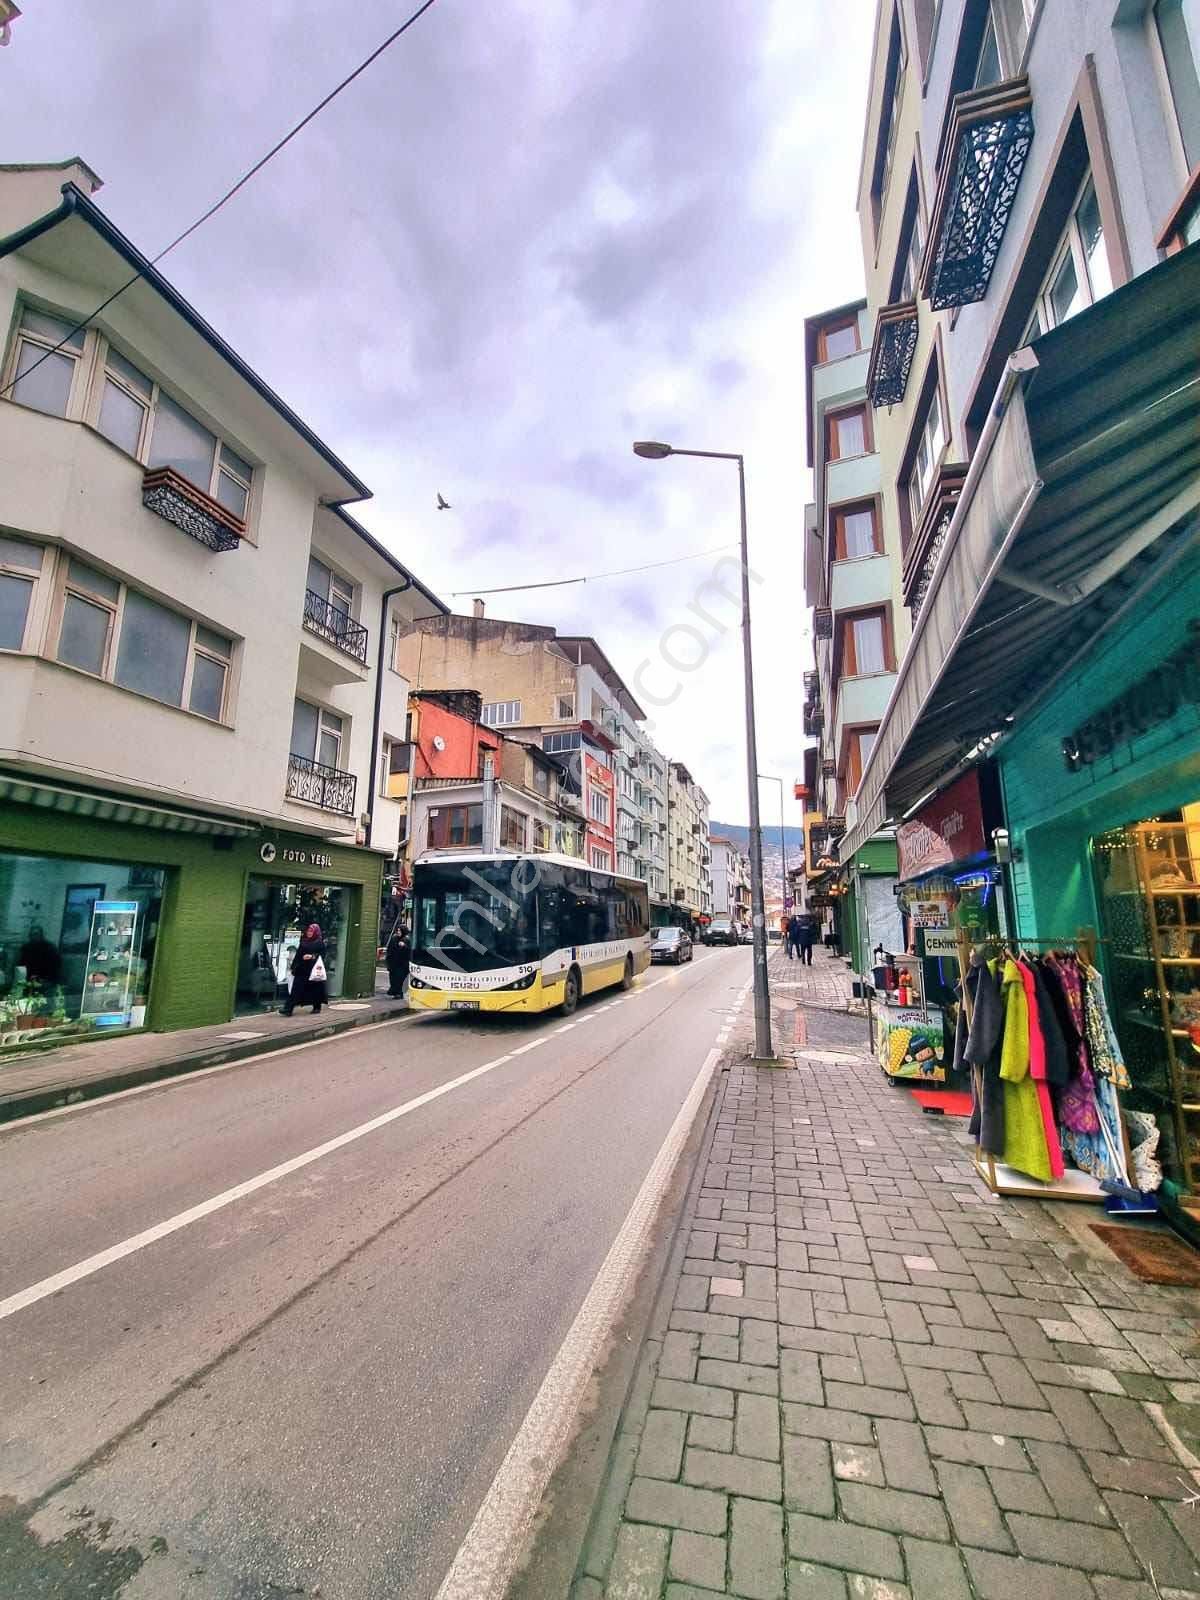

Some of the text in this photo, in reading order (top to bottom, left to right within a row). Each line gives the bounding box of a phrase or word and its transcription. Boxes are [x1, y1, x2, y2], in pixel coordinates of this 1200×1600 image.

[283, 849, 332, 868] FOTO YEŞİL
[519, 965, 533, 974] 510
[450, 982, 480, 990] ISUZU
